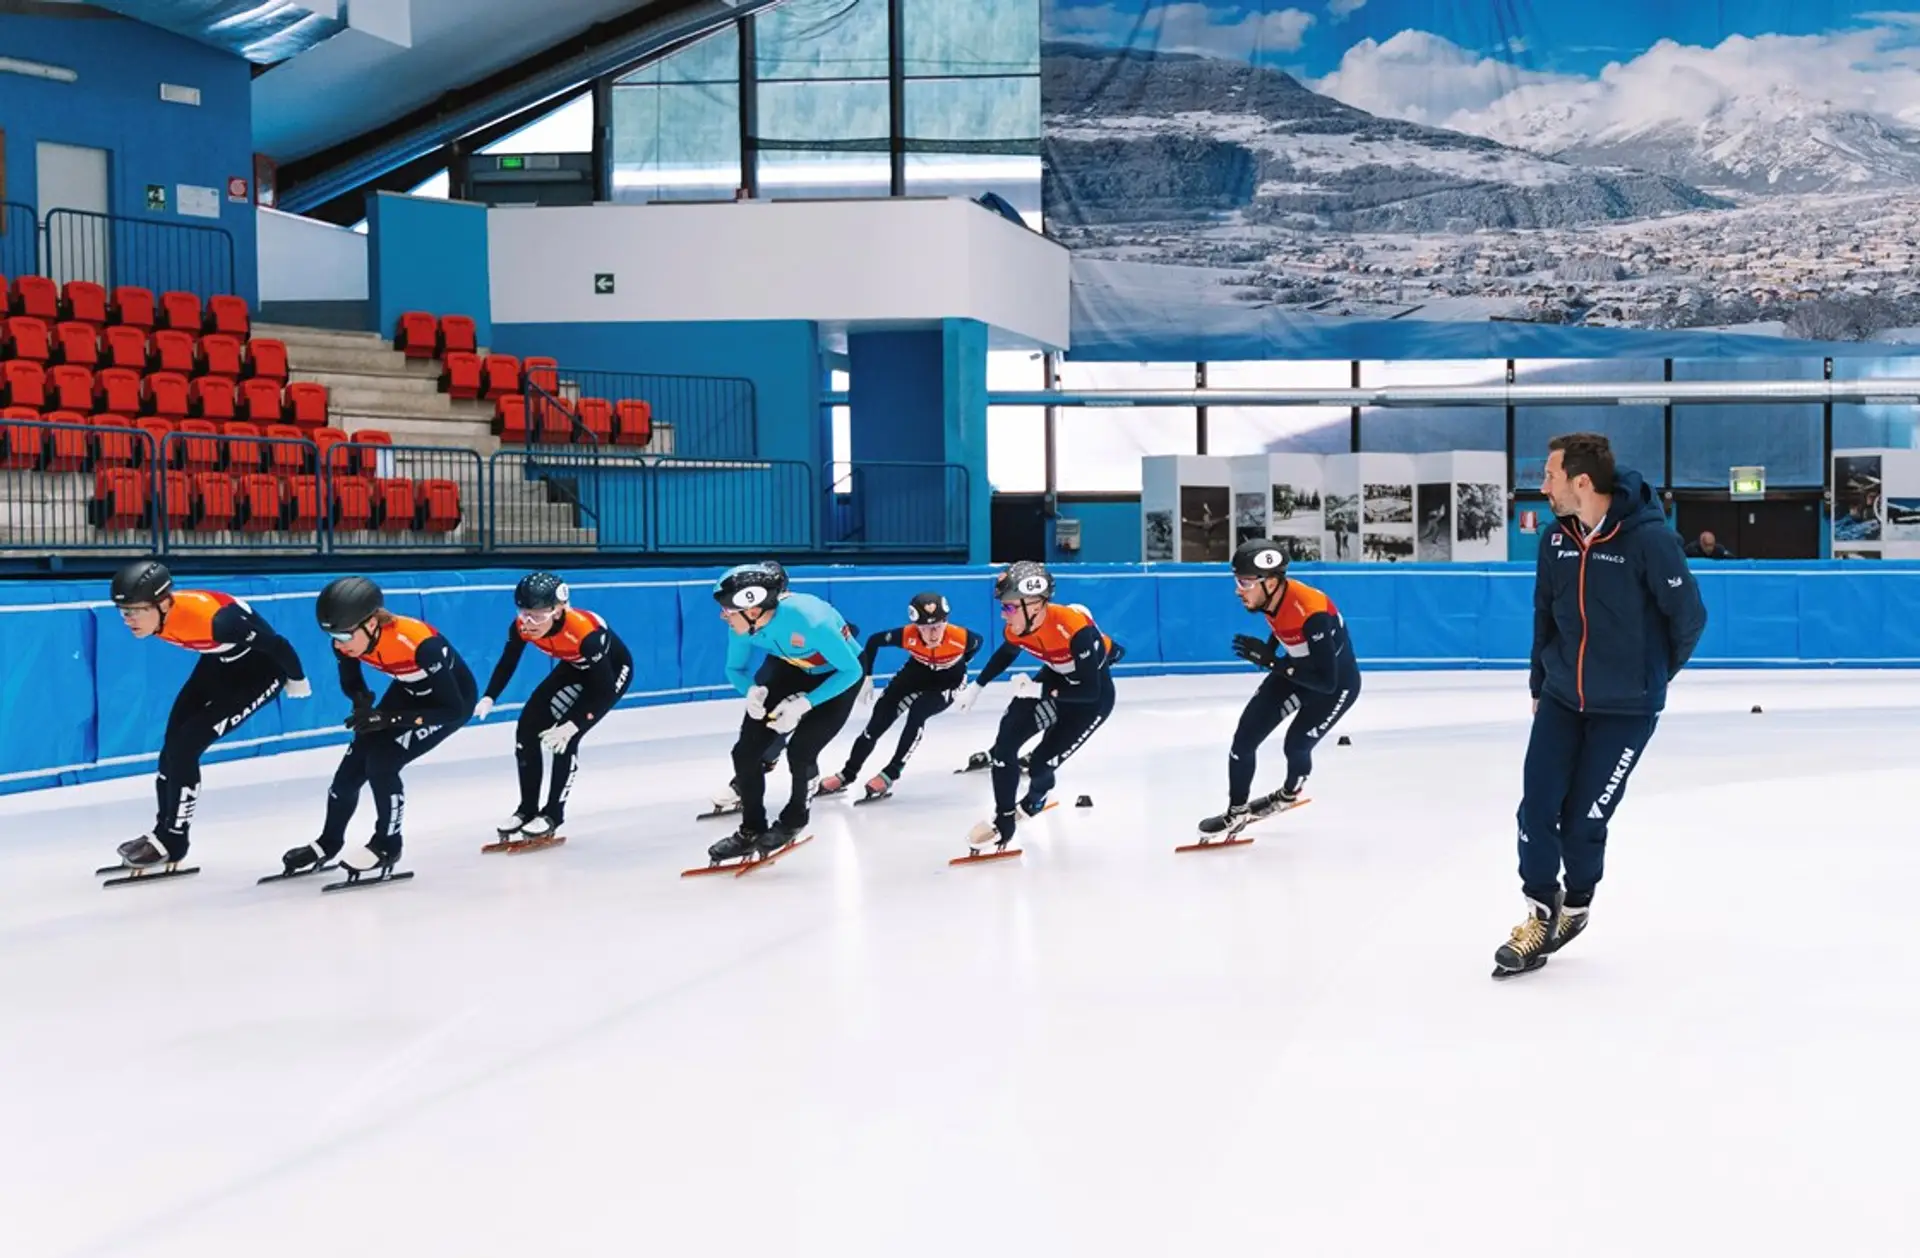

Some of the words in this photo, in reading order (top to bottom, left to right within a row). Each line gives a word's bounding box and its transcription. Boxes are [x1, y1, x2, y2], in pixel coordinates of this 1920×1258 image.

[745, 590, 755, 603] 9
[1026, 579, 1041, 592] 64
[229, 678, 280, 727] DAIKIN
[1598, 747, 1635, 805] DAIKIN
